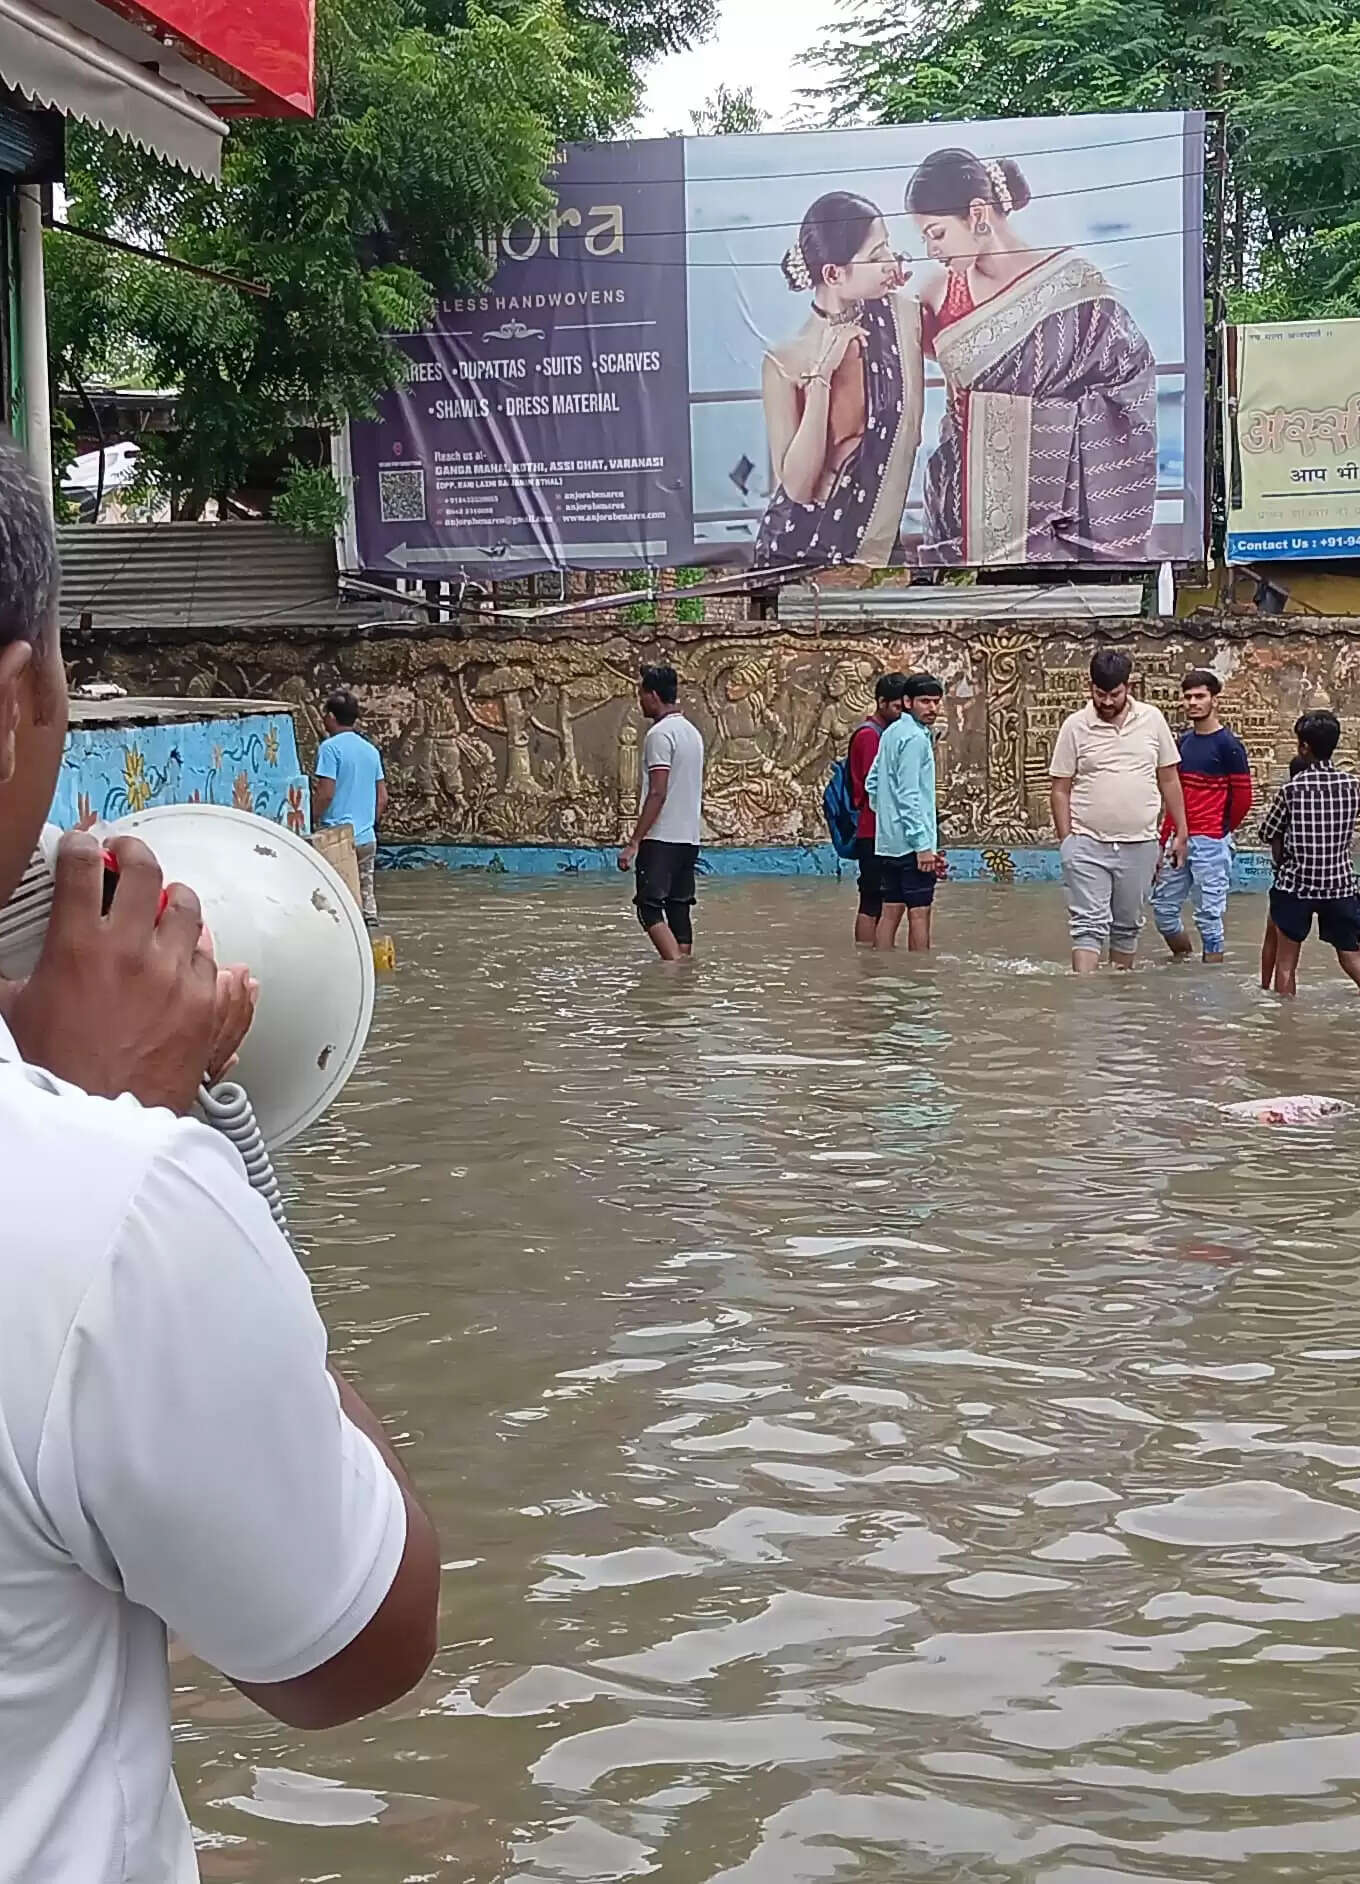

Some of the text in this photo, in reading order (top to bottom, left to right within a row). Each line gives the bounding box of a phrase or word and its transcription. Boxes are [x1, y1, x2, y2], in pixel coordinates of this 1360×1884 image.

[496, 289, 625, 311] HANDWOVENS
[403, 351, 660, 382] AREES DUPATTAS SUITS SCARVES
[436, 392, 620, 419] SHAWLS DRESS MATERIAL
[549, 461, 575, 471] ASSI
[608, 456, 664, 470] VARANASI
[1290, 468, 1327, 482] आप
[1337, 461, 1360, 480] भी
[1237, 539, 1288, 551] Contact
[1292, 538, 1309, 549] Us
